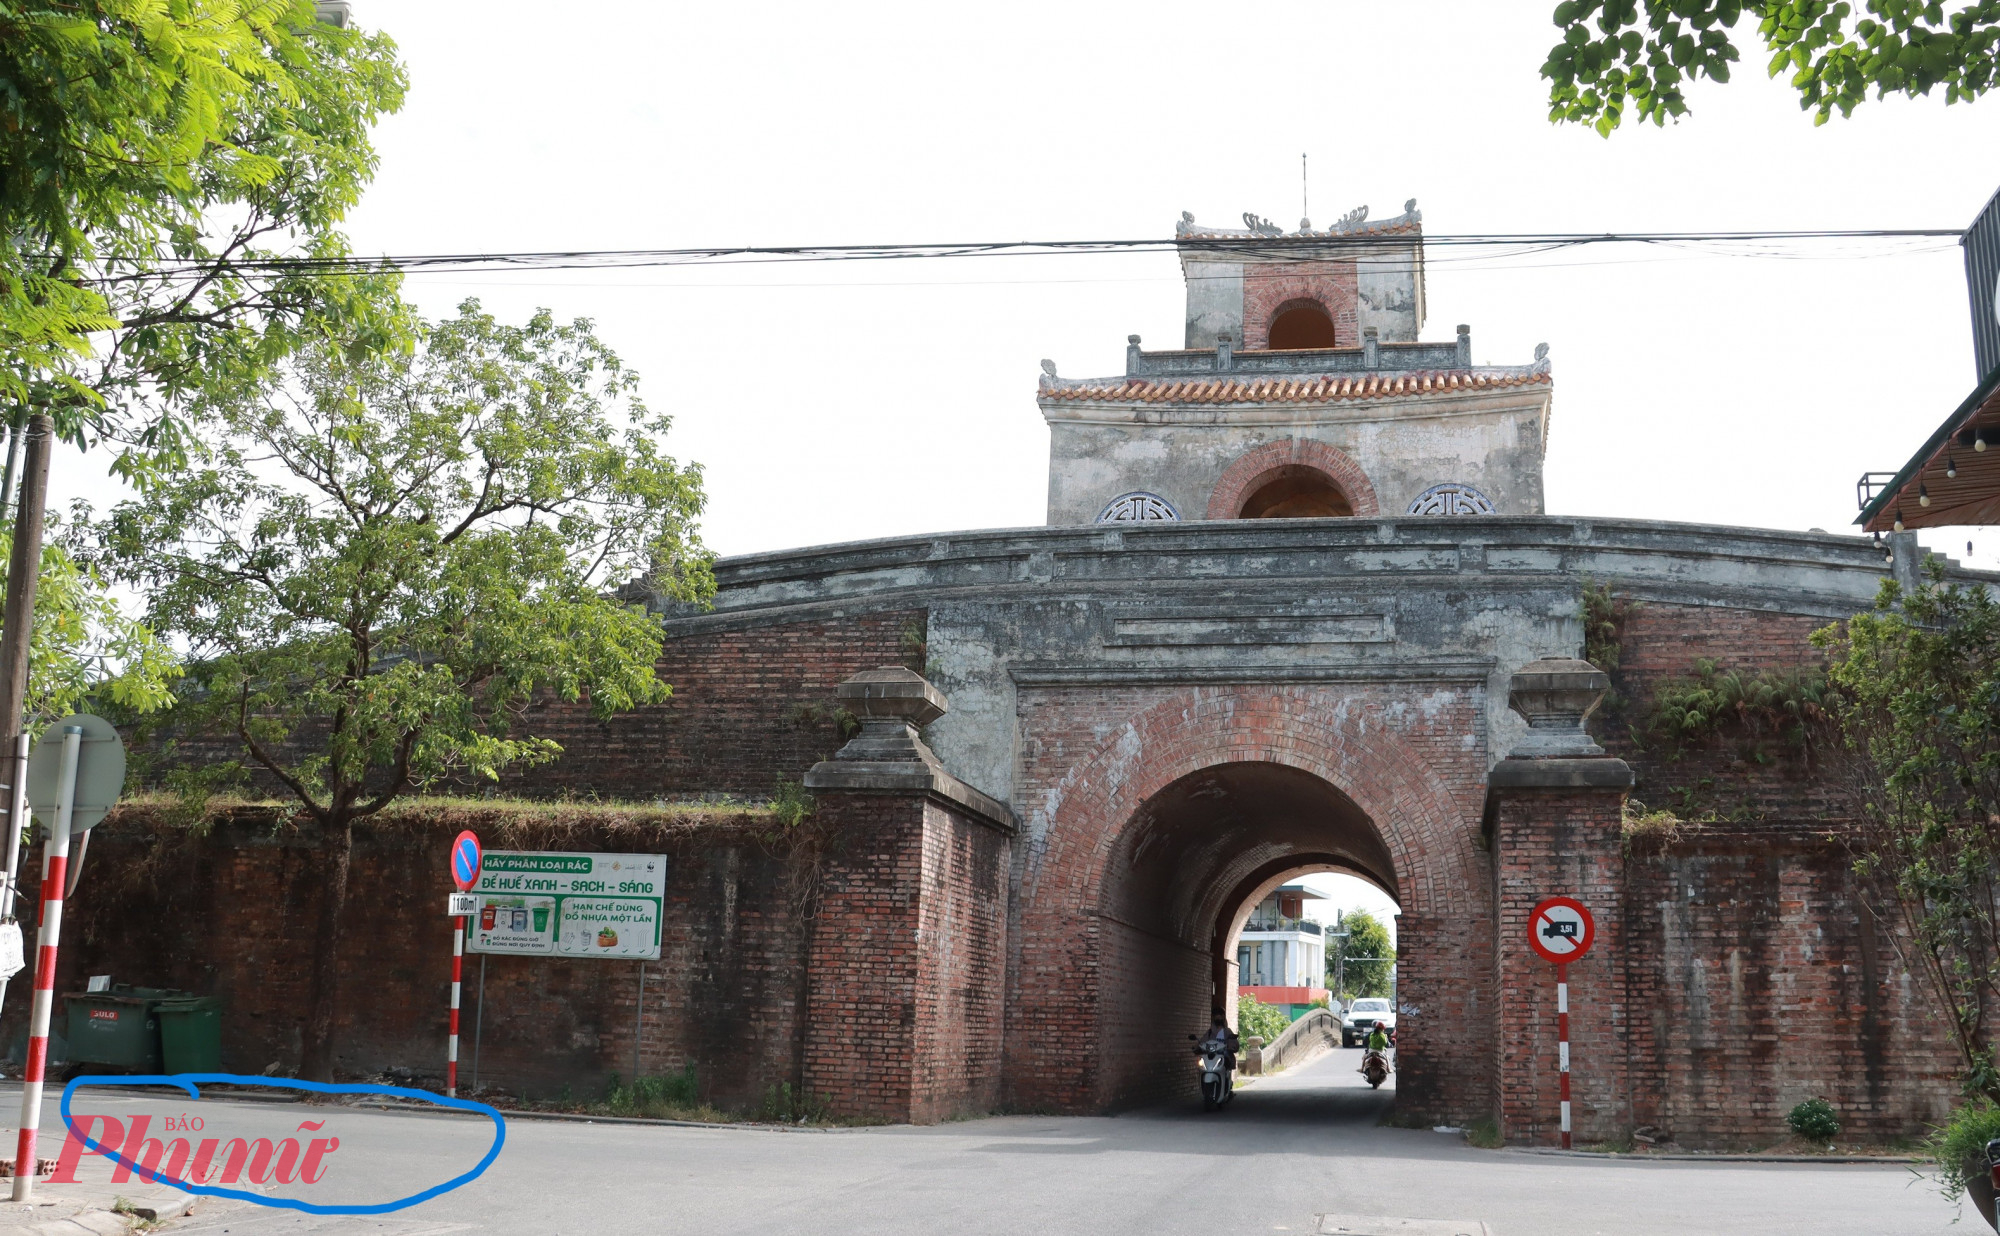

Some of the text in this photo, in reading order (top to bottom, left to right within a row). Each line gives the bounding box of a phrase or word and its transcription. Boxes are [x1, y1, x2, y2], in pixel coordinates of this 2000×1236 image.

[484, 858, 506, 868] HÃY
[508, 858, 538, 869] PHÂN
[540, 861, 565, 872] LOẠI
[567, 860, 589, 870] RÁC
[481, 872, 499, 889] ĐỂ
[499, 874, 525, 890] HUẾ
[524, 879, 558, 891] XANH
[571, 880, 605, 894] SẠCH
[618, 879, 654, 894] SÁNG
[572, 903, 593, 912] HẠN
[595, 901, 615, 912] CHẾ
[610, 913, 632, 924] MỘT
